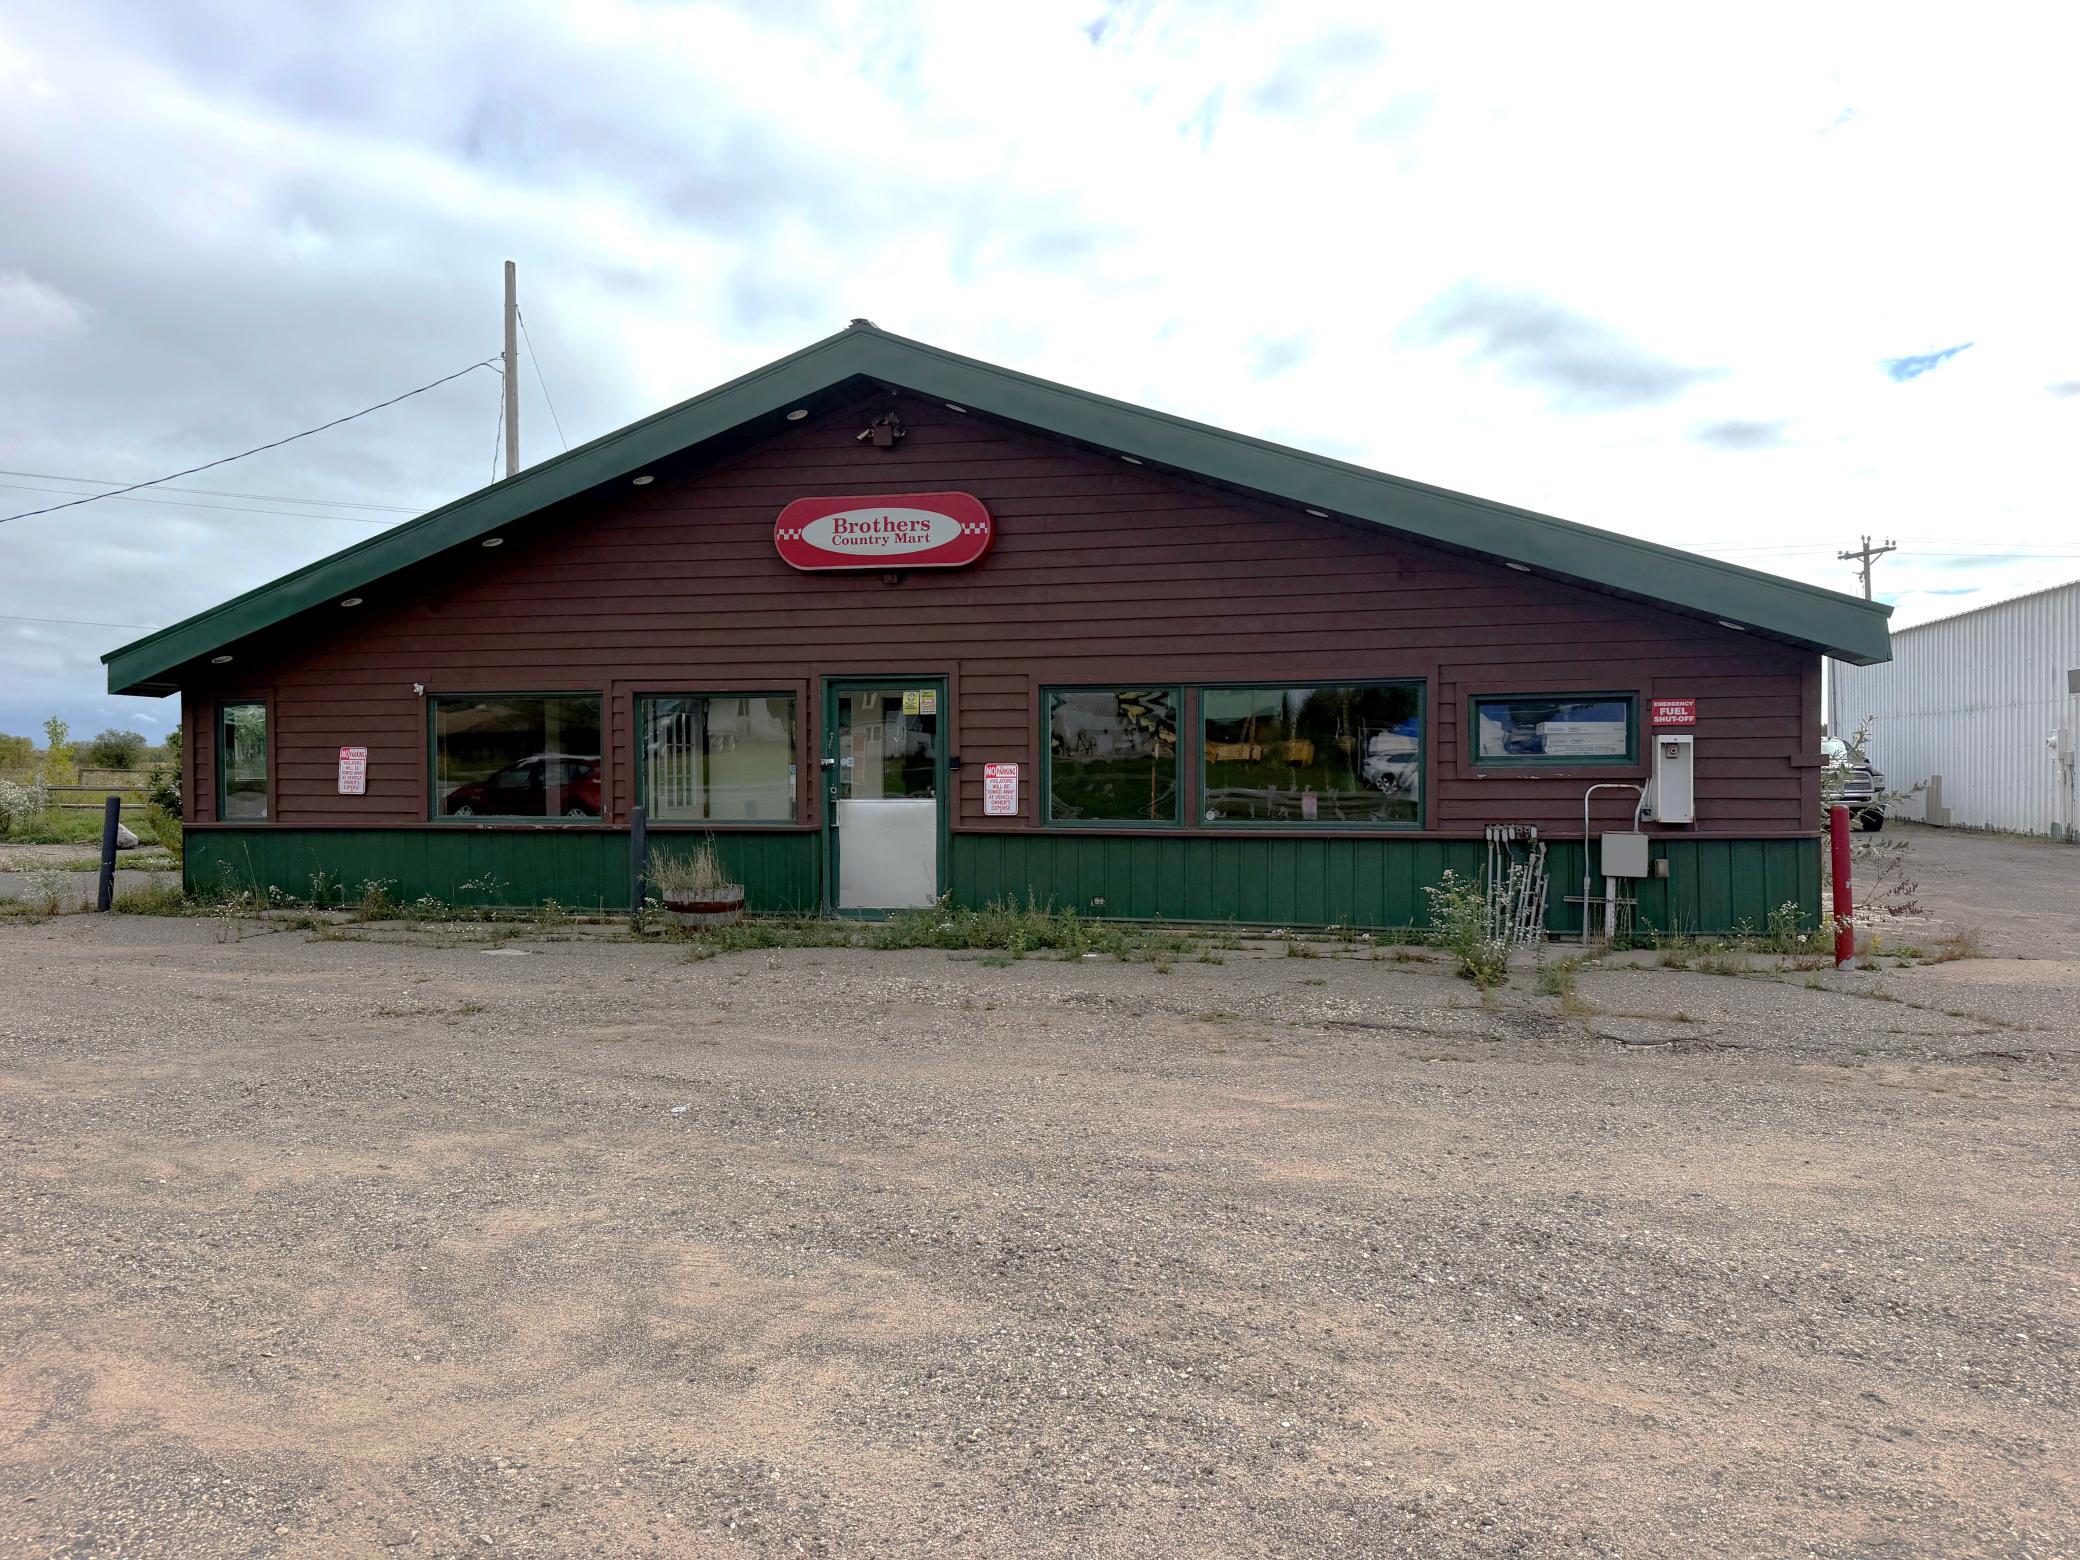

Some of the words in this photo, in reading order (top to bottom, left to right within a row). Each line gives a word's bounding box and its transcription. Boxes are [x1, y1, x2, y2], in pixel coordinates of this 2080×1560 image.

[832, 516, 930, 534] Brothers
[832, 535, 890, 546] Country
[894, 532, 930, 544] Mart
[986, 766, 996, 776] NO
[996, 767, 1016, 776] PARKING
